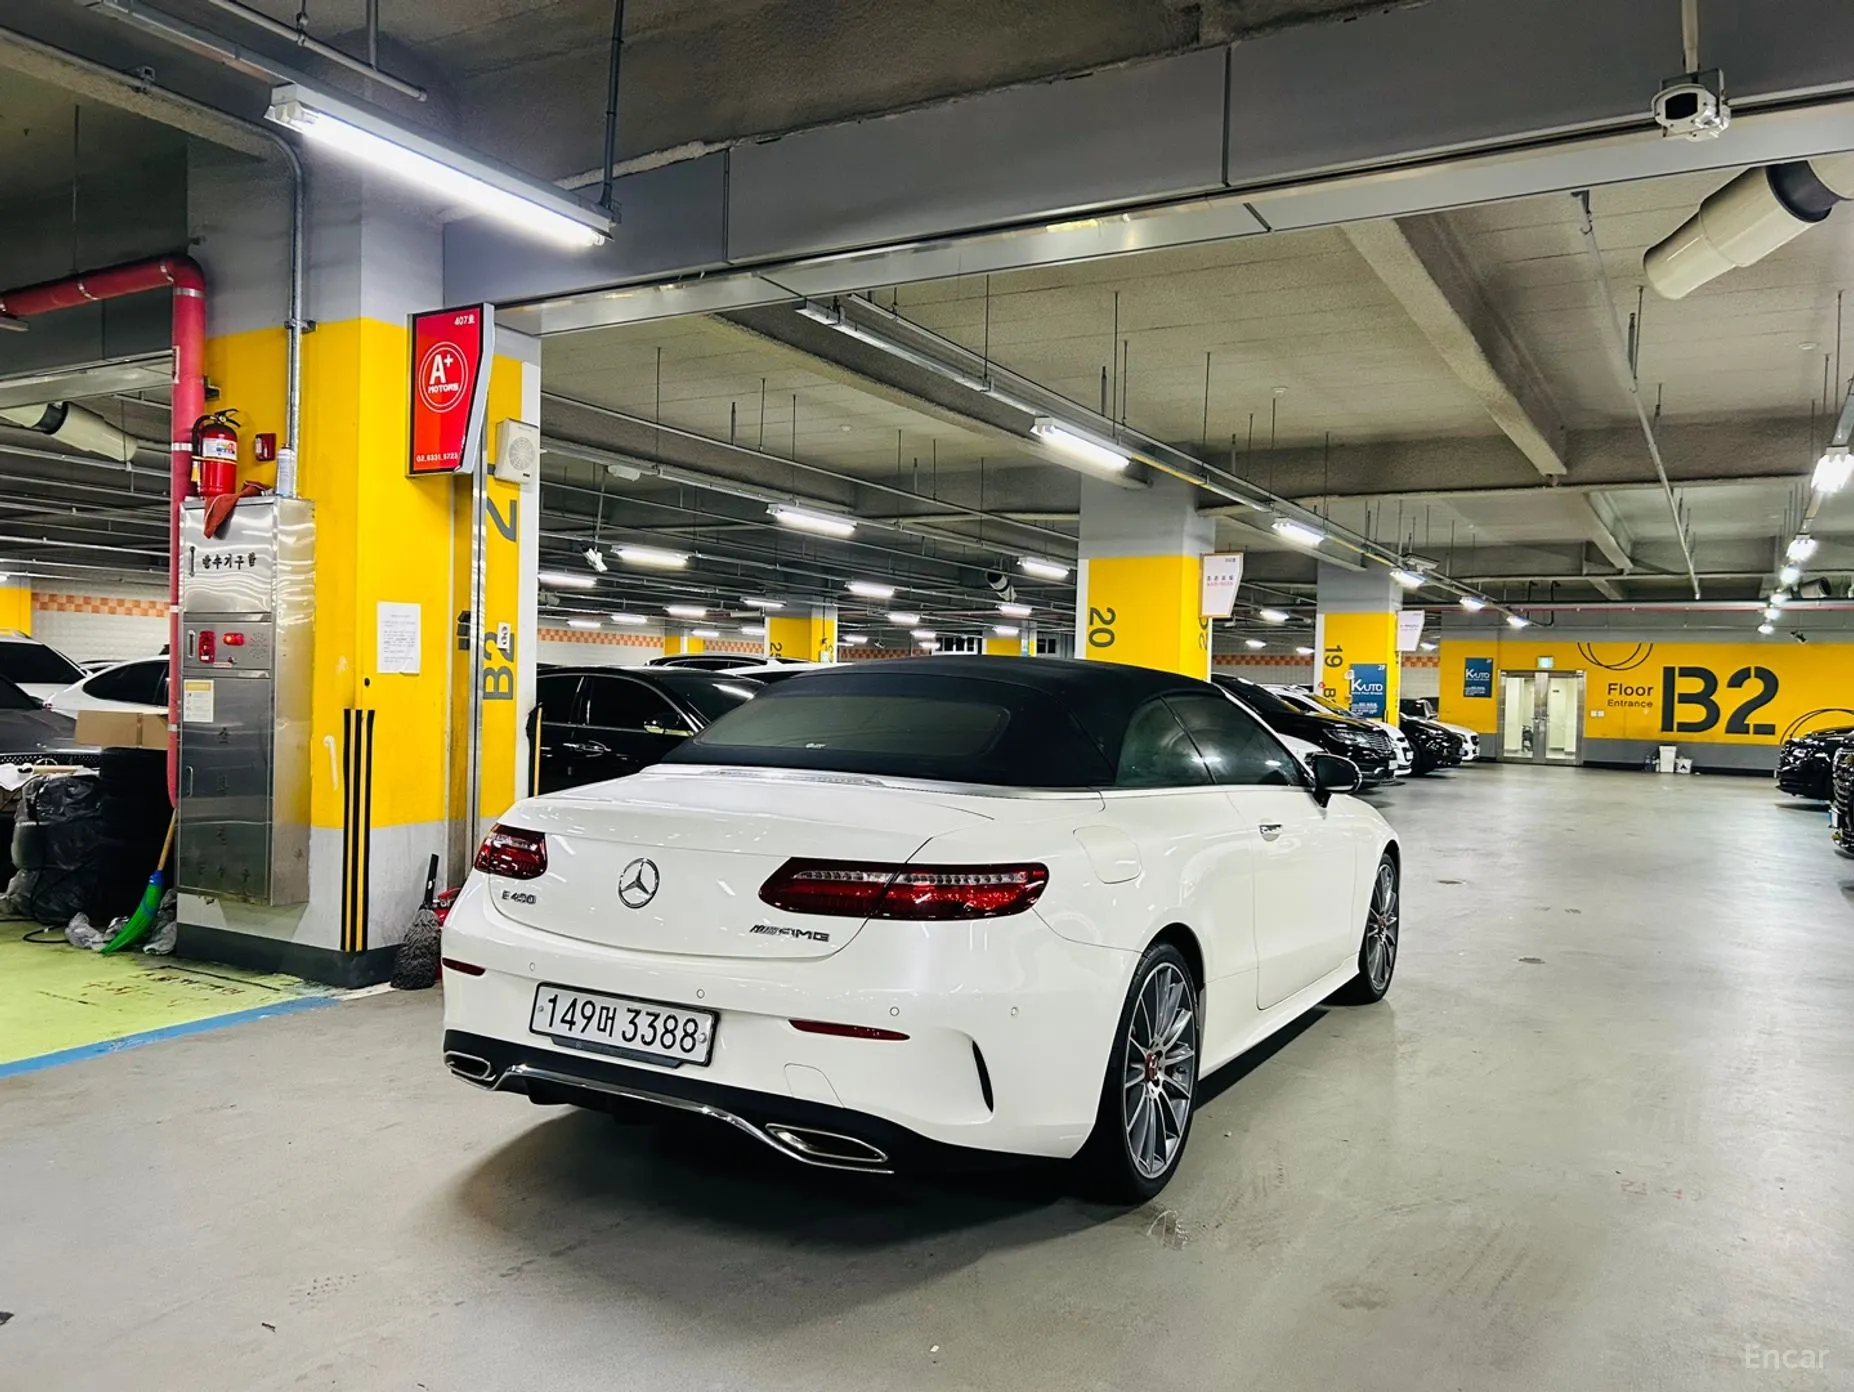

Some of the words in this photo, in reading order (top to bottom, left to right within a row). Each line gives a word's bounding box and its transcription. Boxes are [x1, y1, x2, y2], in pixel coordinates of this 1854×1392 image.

[429, 354, 454, 385] A+
[428, 382, 460, 394] MOTORS
[1088, 607, 1117, 648] 20
[483, 632, 515, 700] B2
[1324, 644, 1343, 668] 19
[1323, 687, 1337, 703] B
[1607, 683, 1654, 697] Floor
[1661, 666, 1780, 736] B2
[1607, 699, 1653, 708] Entrance
[779, 927, 830, 943] AMG
[548, 994, 617, 1038] 149머
[621, 1007, 699, 1053] 3388
